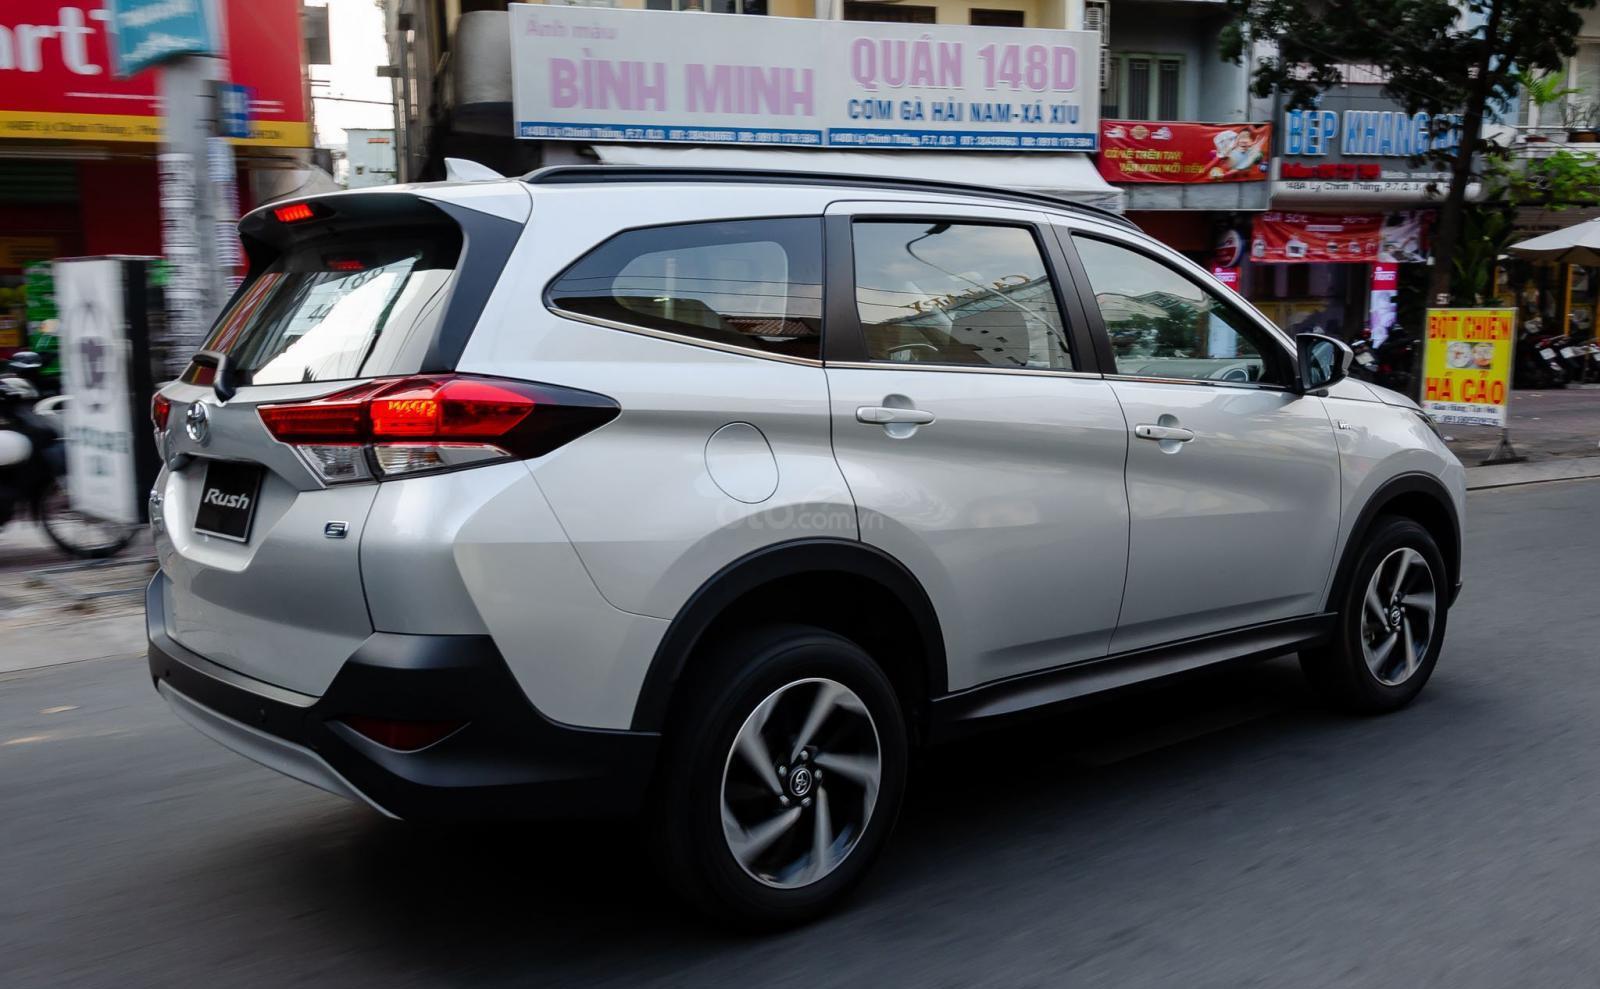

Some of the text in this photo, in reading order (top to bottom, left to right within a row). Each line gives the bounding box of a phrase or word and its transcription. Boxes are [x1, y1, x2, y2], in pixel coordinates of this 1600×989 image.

[548, 47, 815, 117] BÌNH MINH
[852, 34, 1077, 92] QUÁN 148D
[848, 97, 893, 121] CƠM
[902, 96, 925, 121] GÀ
[932, 96, 964, 122] HẢI
[1049, 100, 1079, 124] XÍU
[204, 488, 250, 510] Rush
